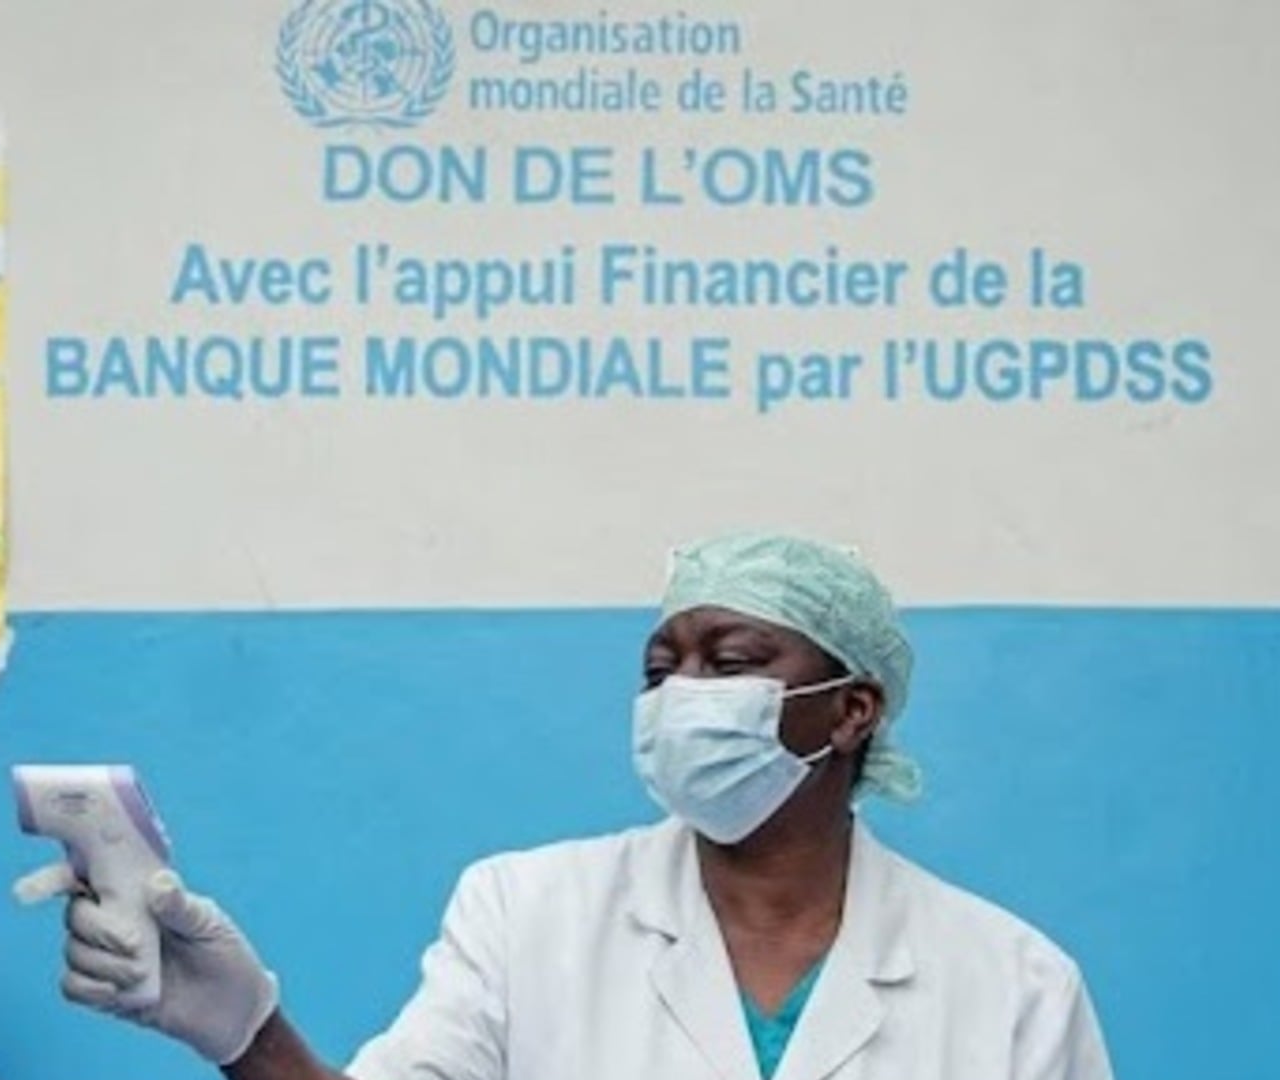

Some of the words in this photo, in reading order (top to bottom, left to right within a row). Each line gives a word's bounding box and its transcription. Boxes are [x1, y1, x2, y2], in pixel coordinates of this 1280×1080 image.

[470, 11, 740, 62] Organisation
[469, 71, 661, 113] mondiale
[677, 72, 724, 113] de
[741, 72, 777, 113] la
[791, 70, 908, 116] Santé
[323, 145, 488, 203] DON
[514, 147, 613, 205] DE
[170, 244, 331, 307] Avec
[600, 245, 908, 308] Financier
[929, 248, 1008, 308] de
[1029, 249, 1087, 309] la
[44, 336, 341, 403] BANQUE
[364, 336, 730, 400] MONDIALE
[756, 351, 862, 413] par
